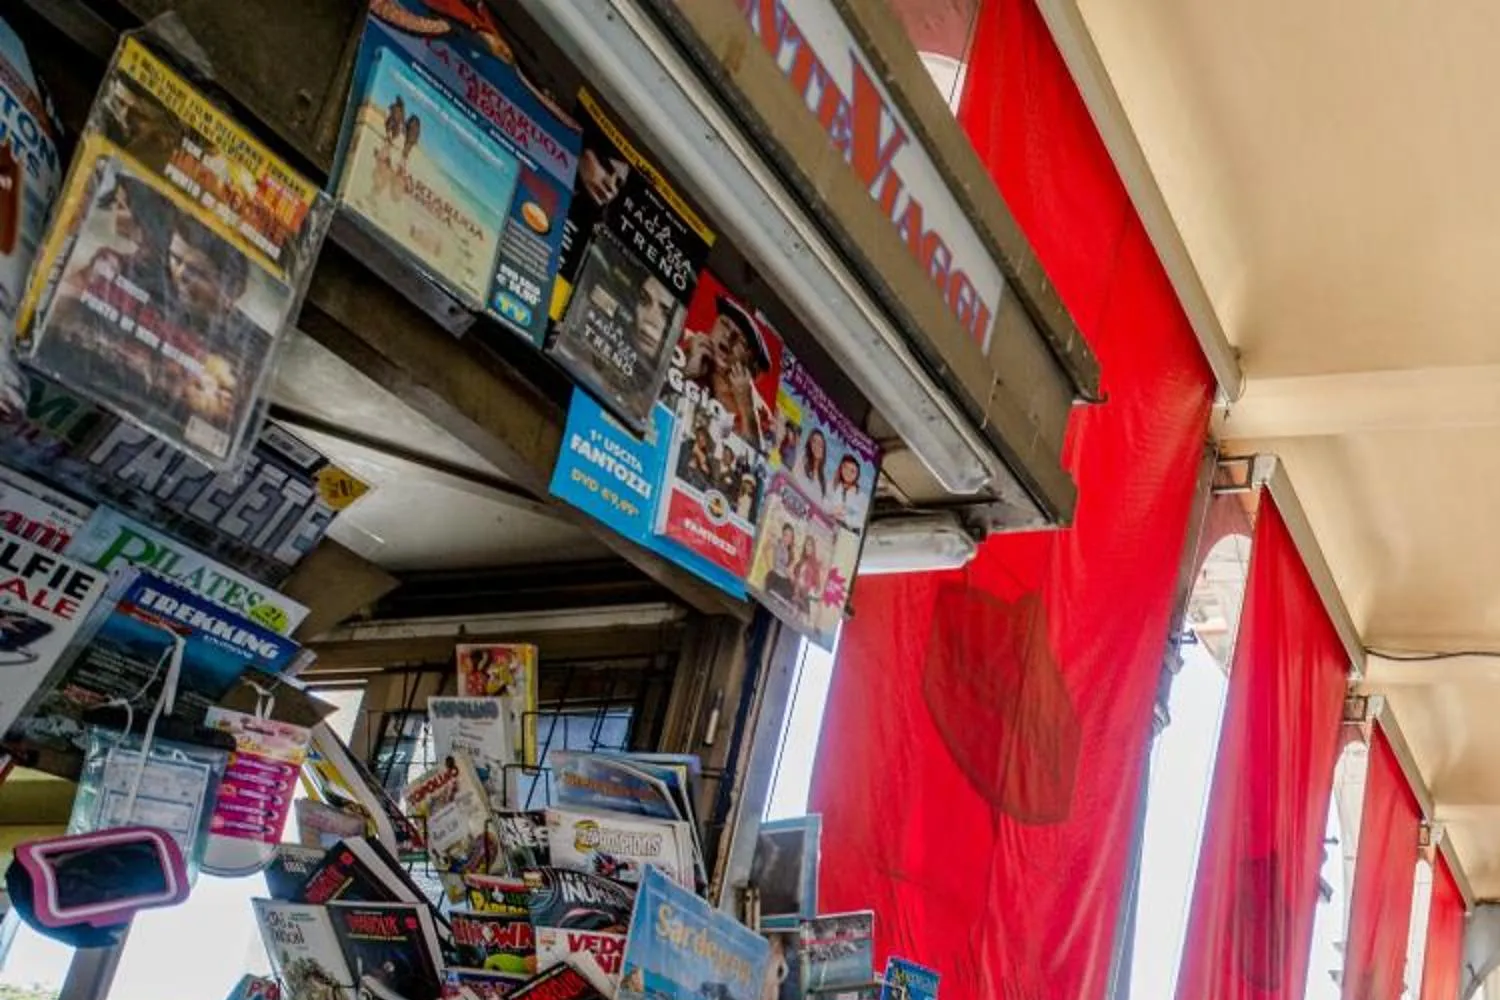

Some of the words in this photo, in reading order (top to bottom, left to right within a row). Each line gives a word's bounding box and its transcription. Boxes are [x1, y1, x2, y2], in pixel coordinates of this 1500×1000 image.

[620, 218, 688, 291] TRENO
[569, 433, 652, 500] FANTOZZI
[0, 536, 96, 601] LFIE
[136, 586, 281, 660] TREKKING
